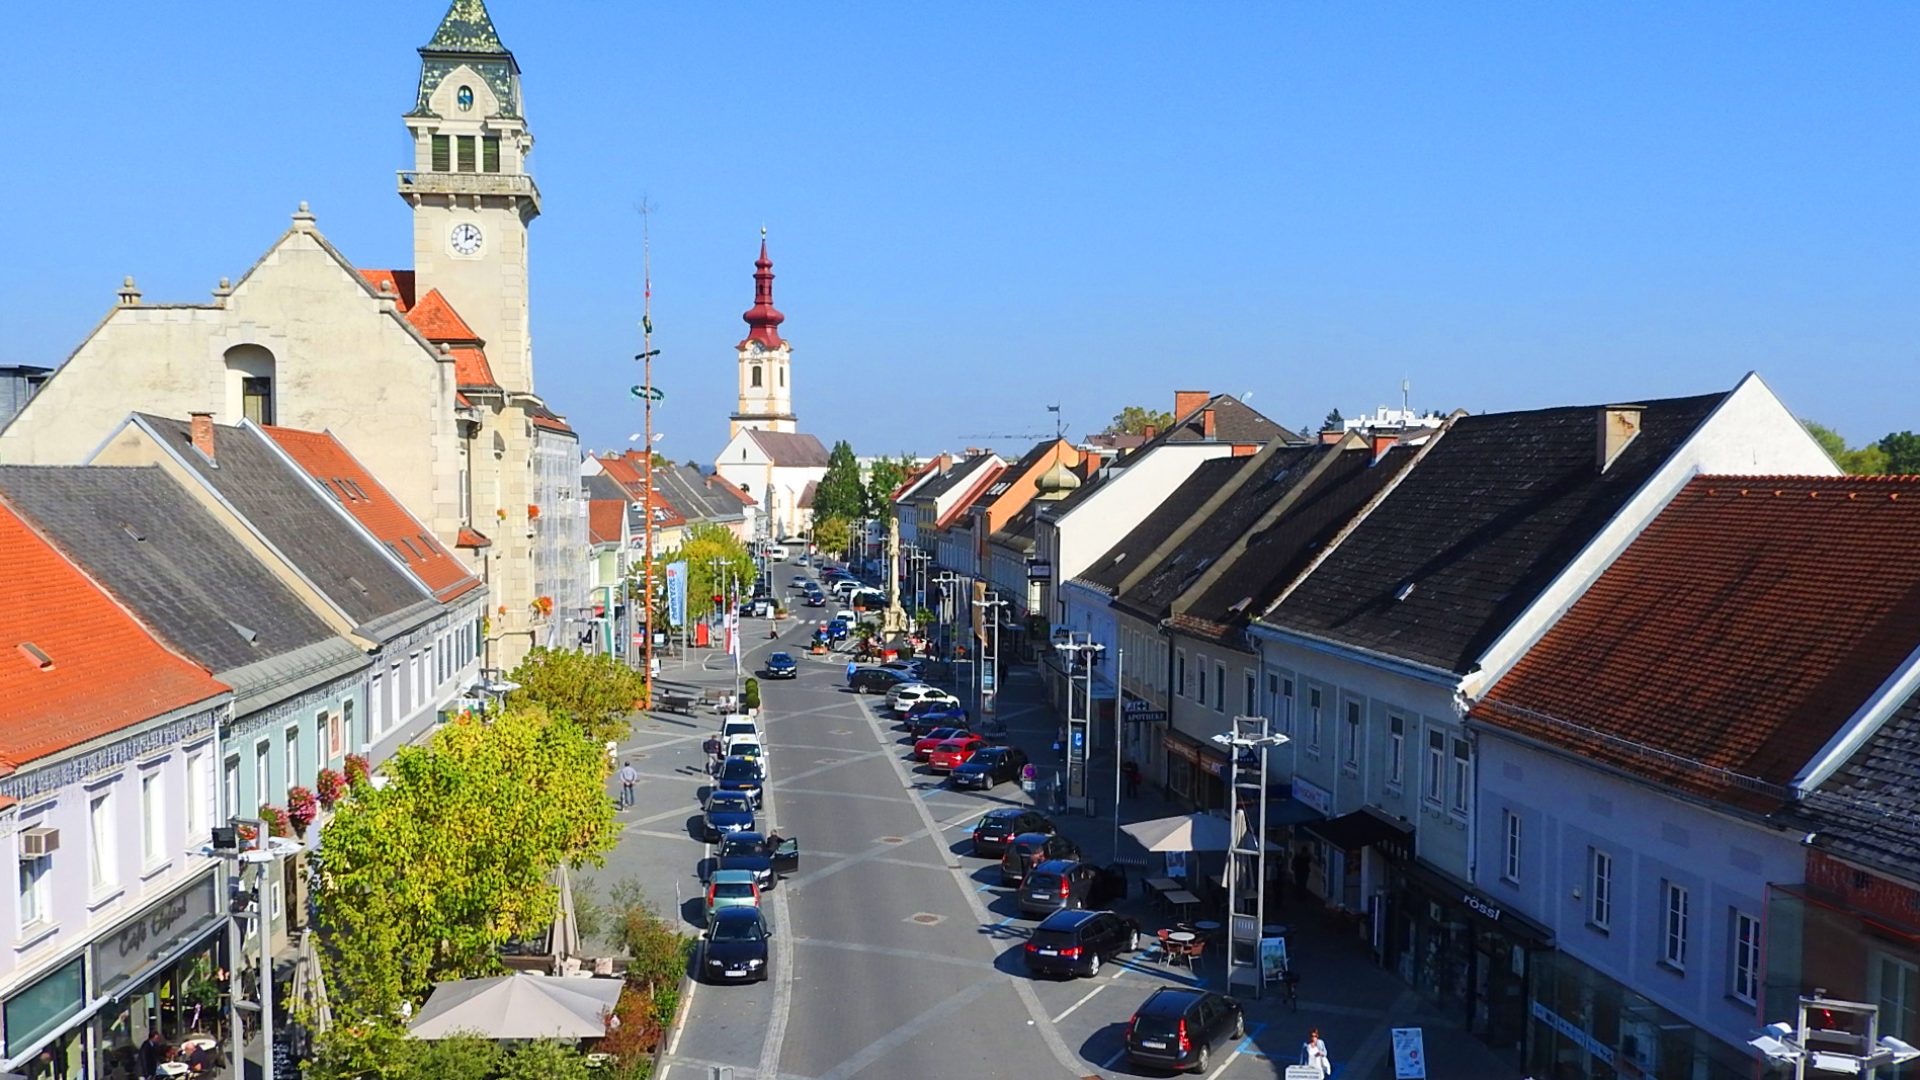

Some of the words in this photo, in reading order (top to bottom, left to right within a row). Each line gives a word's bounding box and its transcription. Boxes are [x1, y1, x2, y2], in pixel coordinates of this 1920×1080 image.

[1055, 626, 1070, 635] dm
[1127, 711, 1165, 721] APOTHEKE
[1463, 894, 1501, 921] rössl
